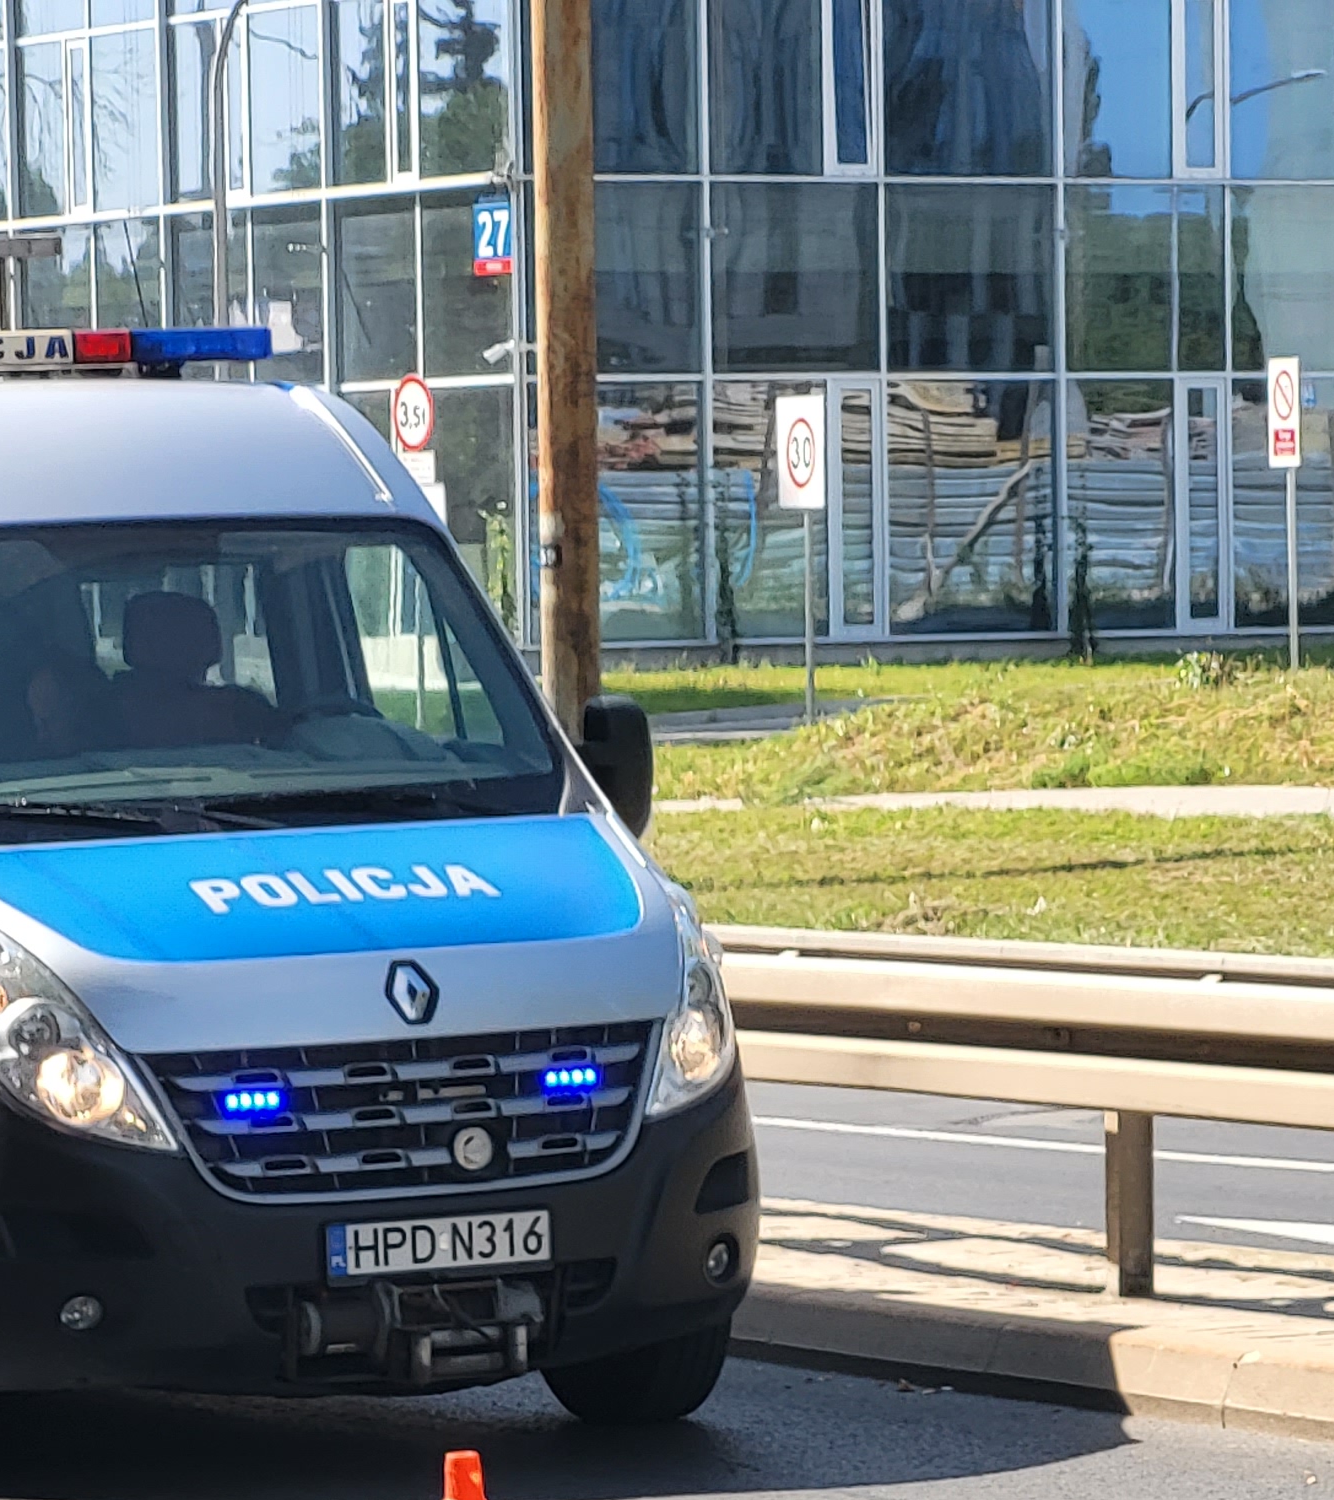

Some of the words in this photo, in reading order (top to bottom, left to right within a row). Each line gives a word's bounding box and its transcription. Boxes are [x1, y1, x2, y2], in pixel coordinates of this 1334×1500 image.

[477, 209, 510, 258] 27
[791, 436, 812, 469] 30
[188, 863, 503, 915] POLICJA
[353, 1224, 437, 1269] HPD
[450, 1215, 544, 1262] N316
